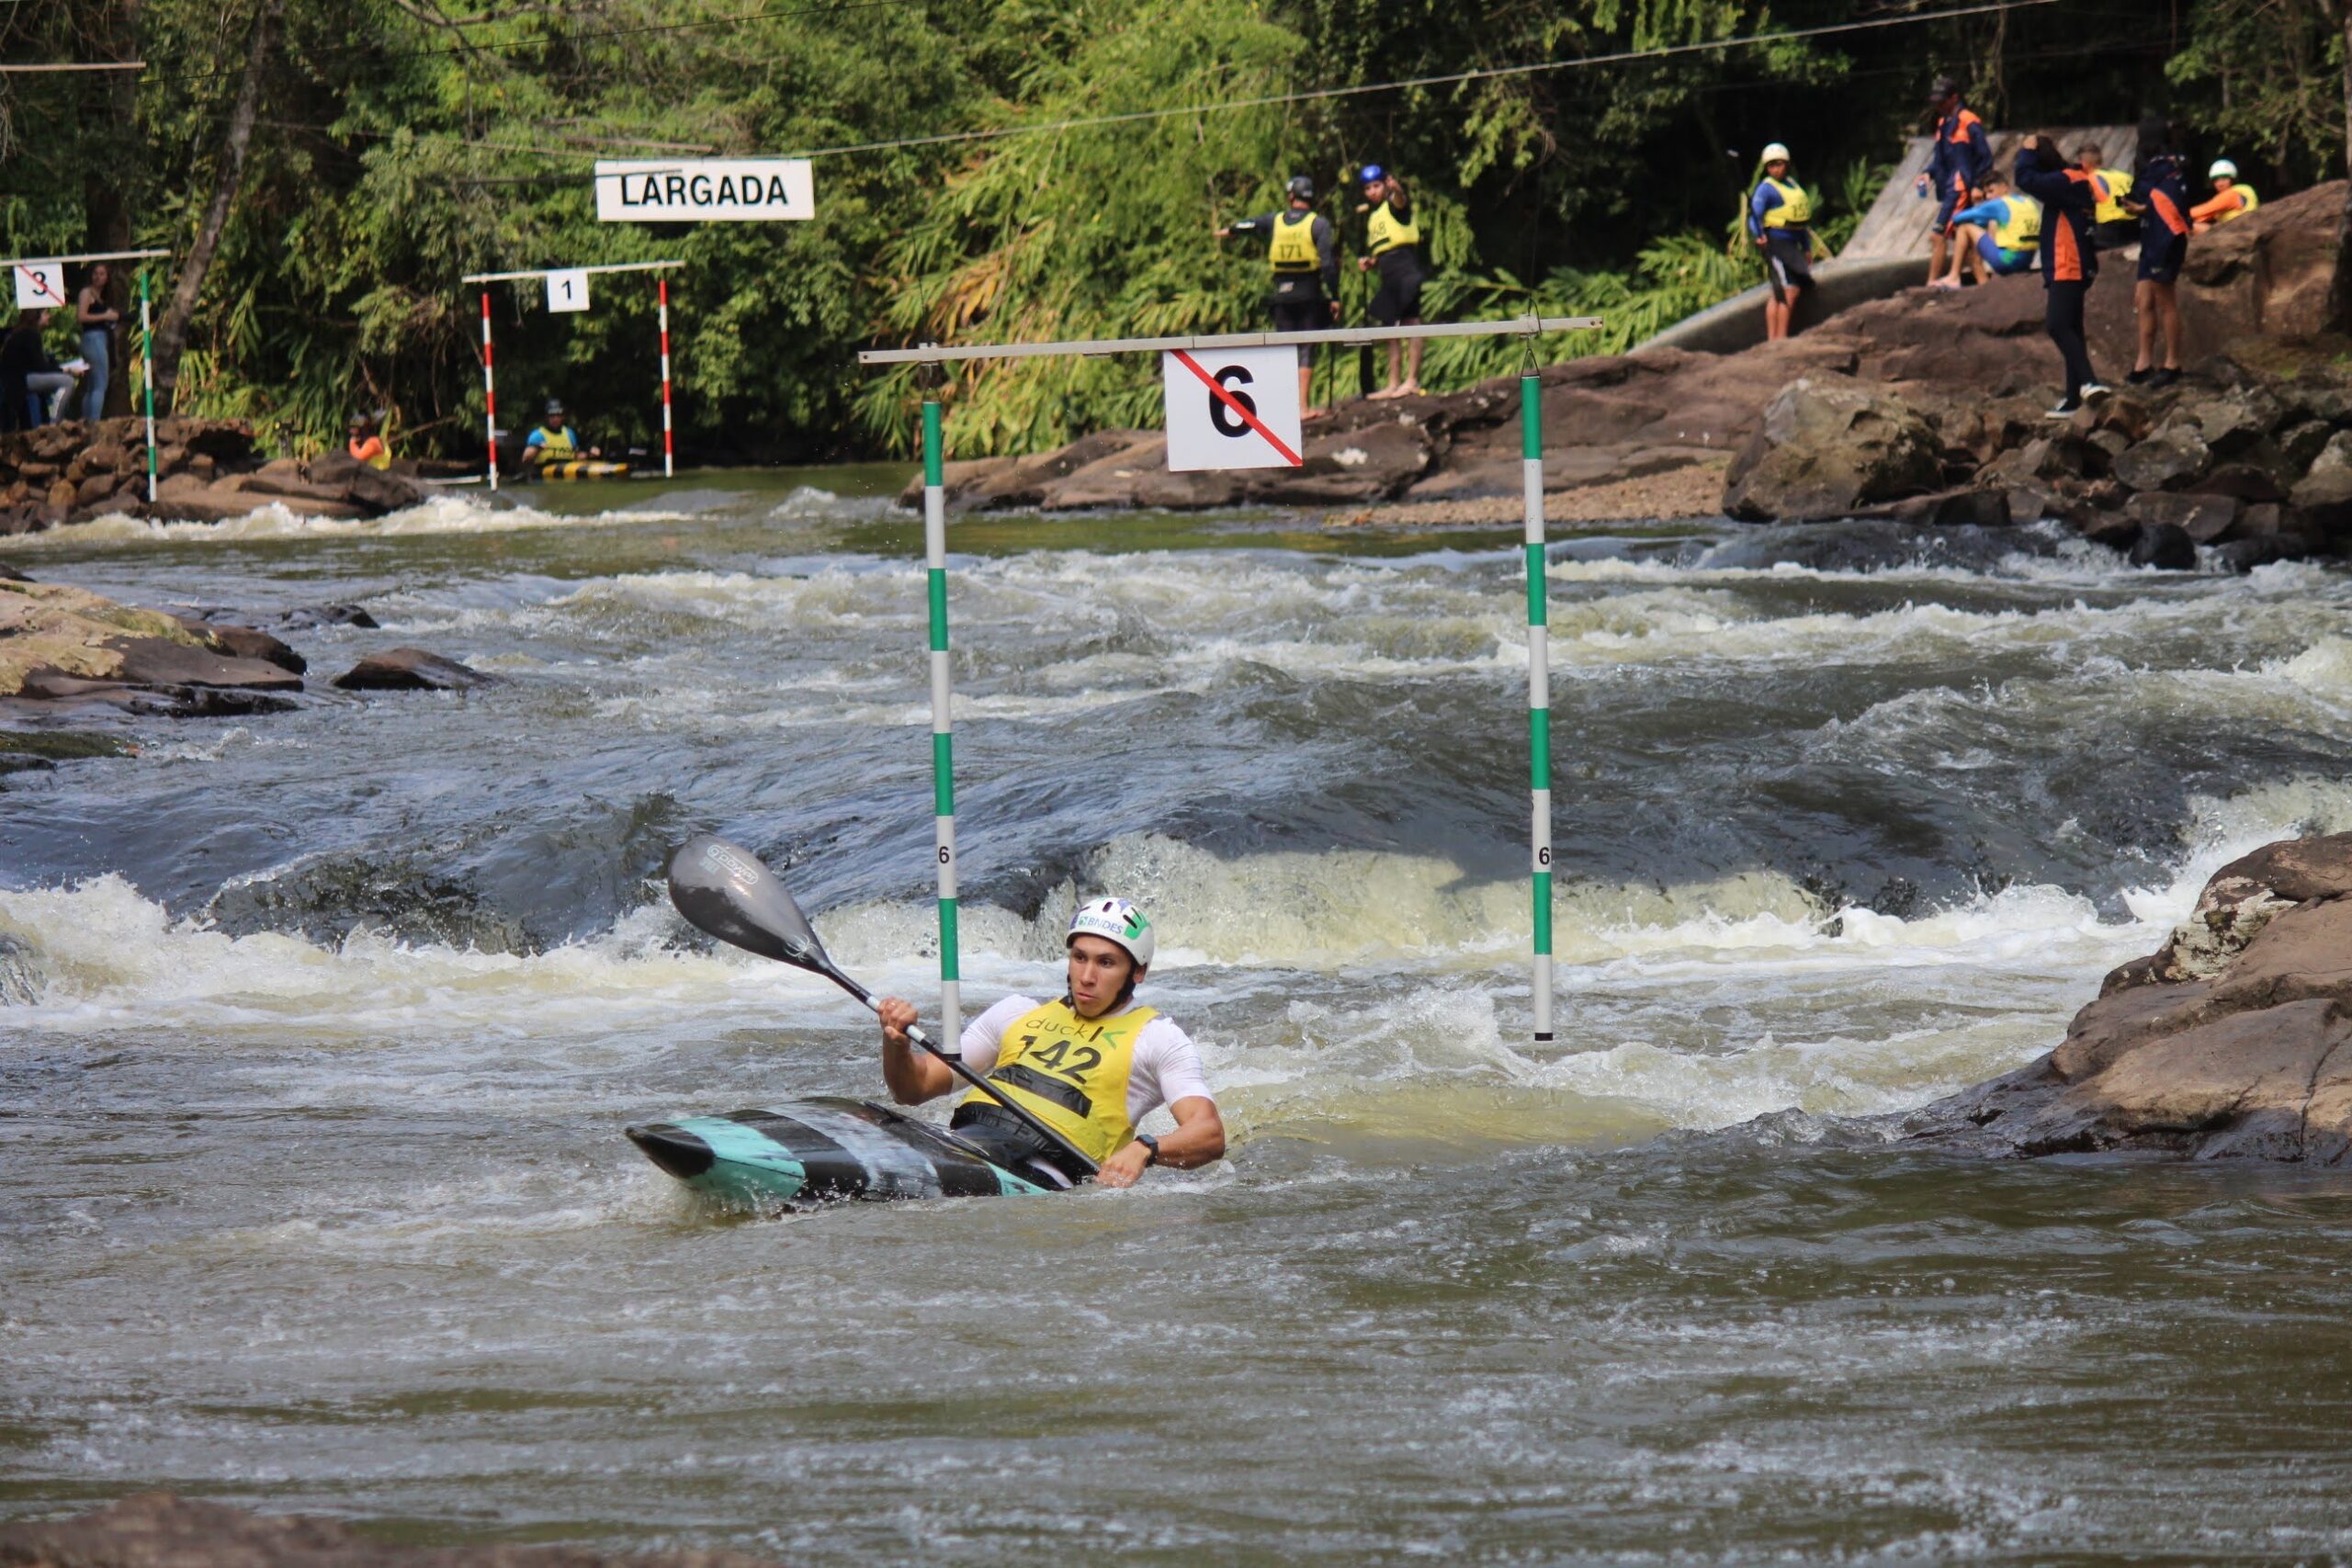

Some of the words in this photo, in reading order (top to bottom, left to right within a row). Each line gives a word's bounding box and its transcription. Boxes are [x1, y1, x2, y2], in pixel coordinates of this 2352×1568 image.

[620, 175, 788, 207] LARGADA
[1280, 243, 1302, 258] 171
[32, 271, 47, 296] 3
[560, 280, 571, 300] 1
[1209, 365, 1257, 438] 6
[939, 846, 950, 864] 6
[1538, 846, 1550, 865] 6
[1087, 917, 1124, 934] BNDES
[1016, 1034, 1102, 1086] 142
